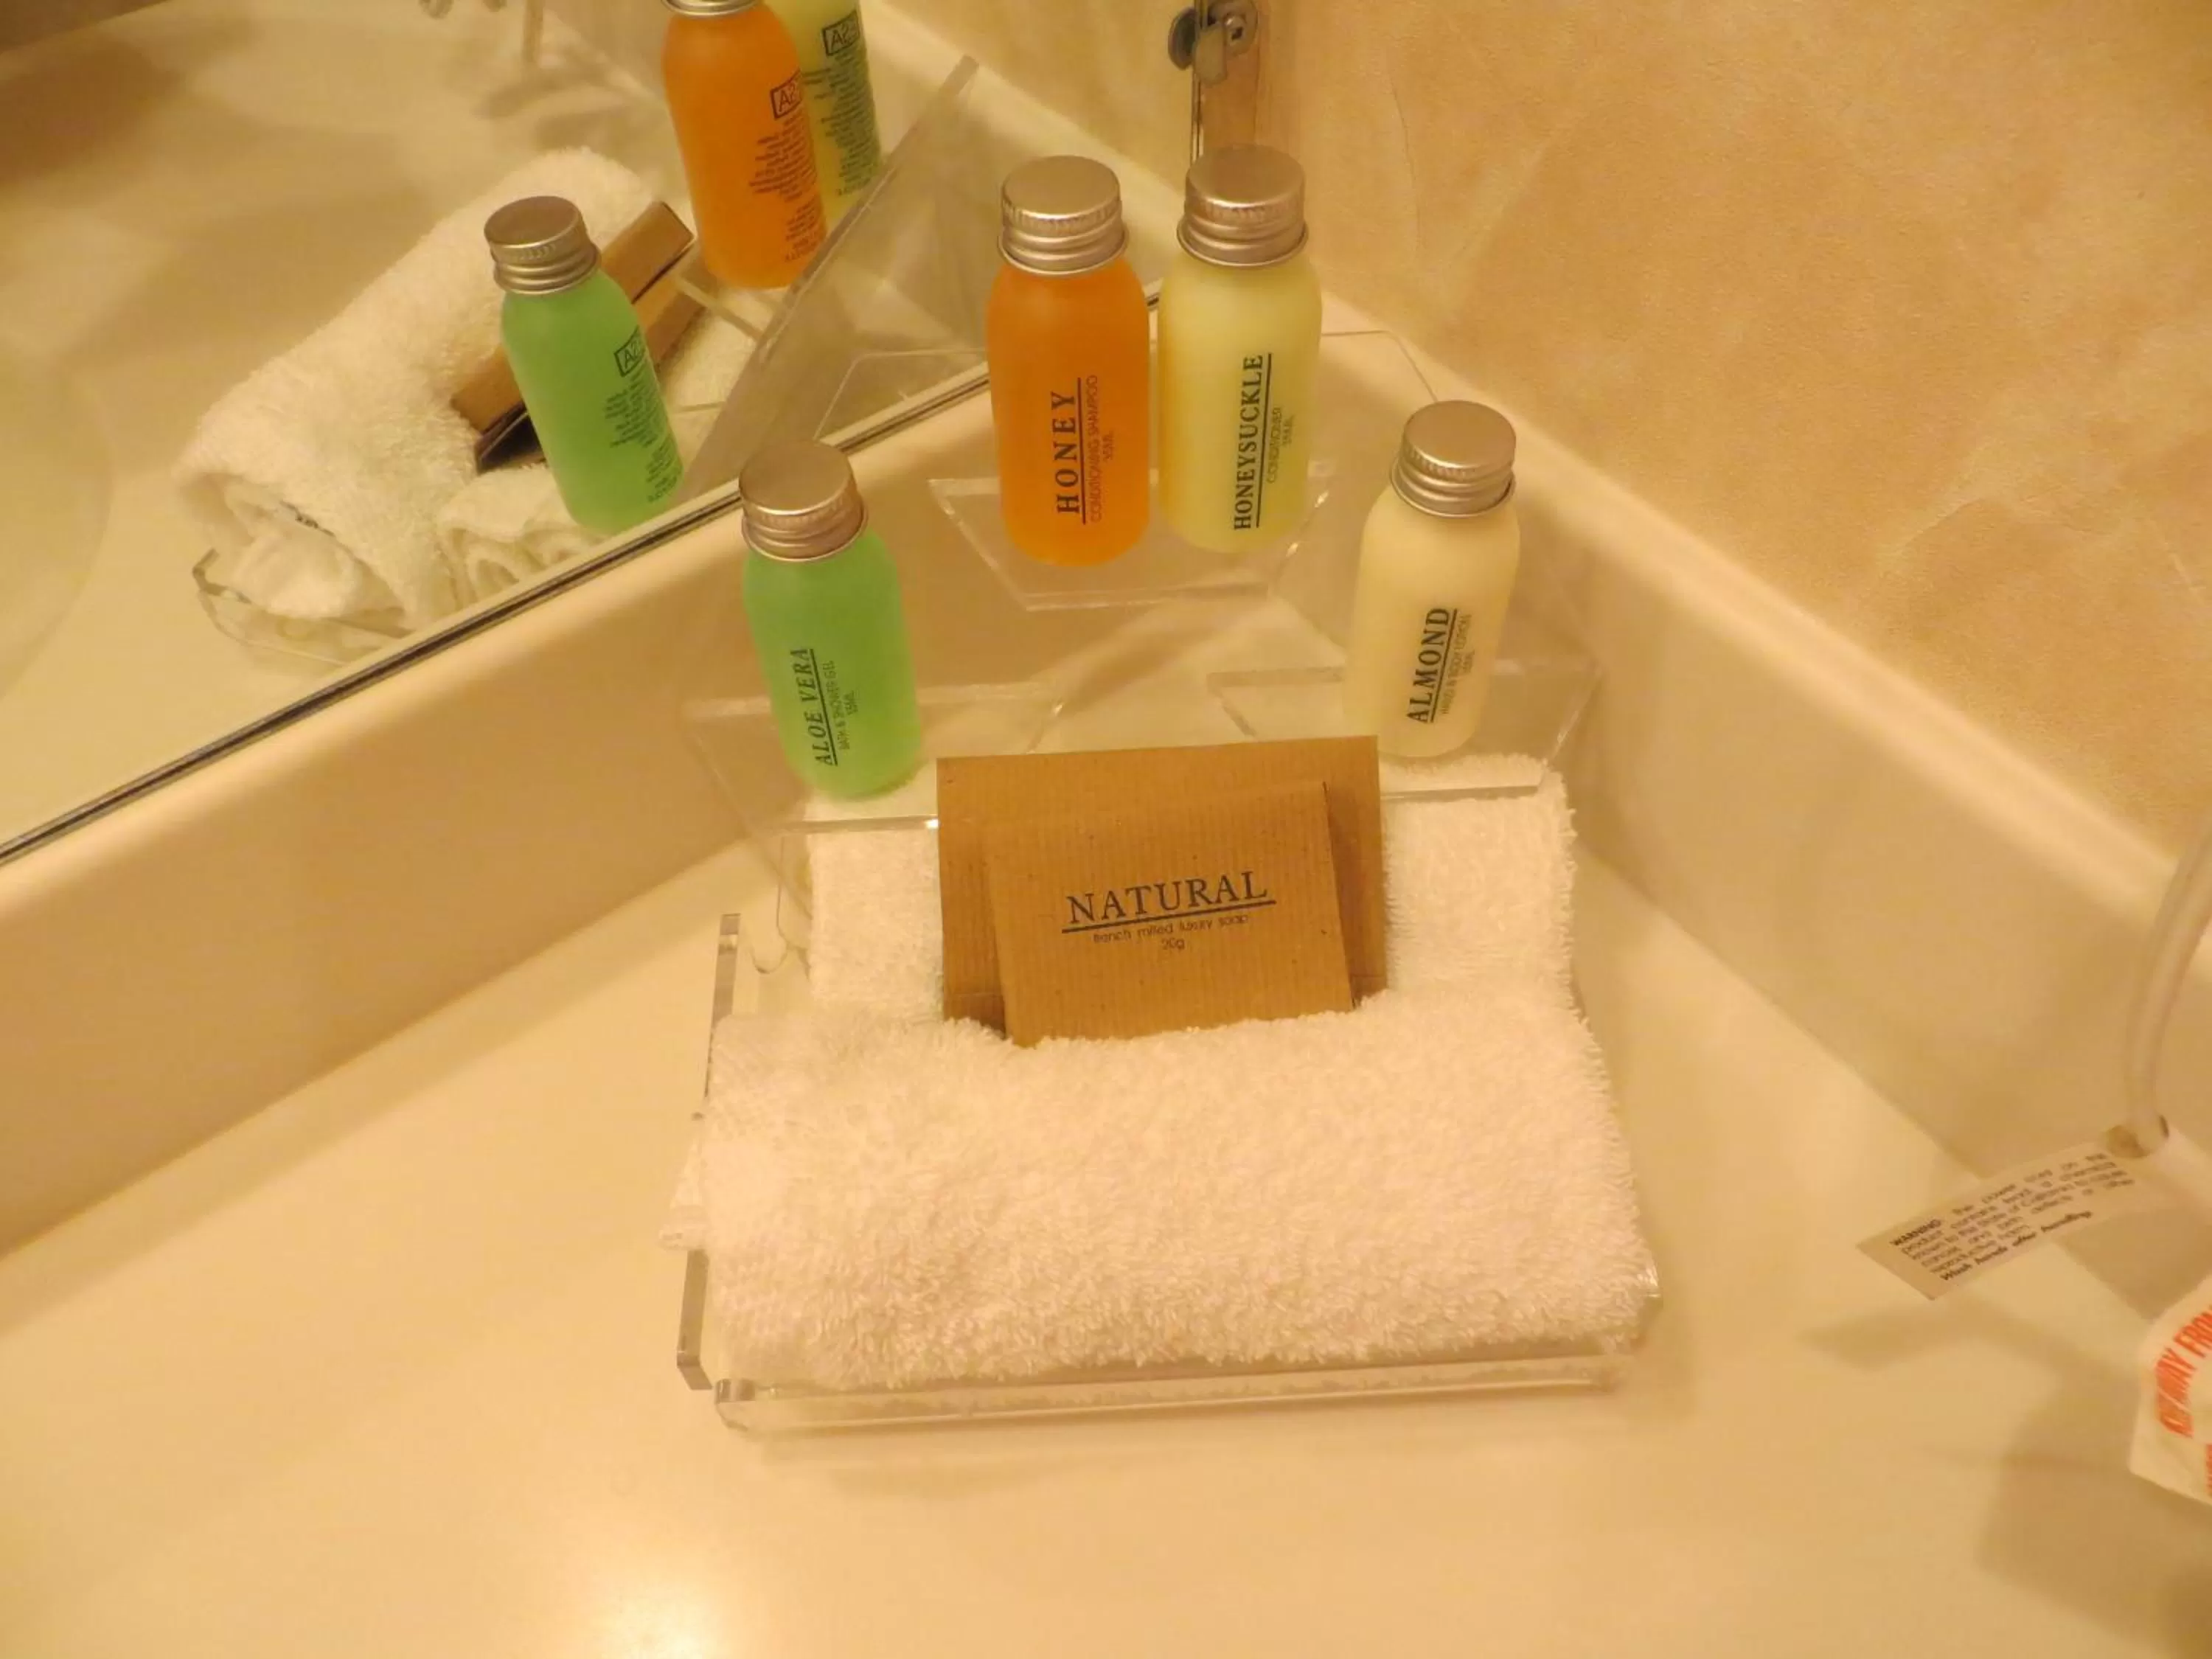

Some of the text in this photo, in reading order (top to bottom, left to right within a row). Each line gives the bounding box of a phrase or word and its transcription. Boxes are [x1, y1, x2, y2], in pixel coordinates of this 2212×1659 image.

[1050, 391, 1080, 514] HONEY
[1234, 355, 1263, 530] HONEYSUCKLE
[790, 648, 833, 766] ALOE VERA
[1406, 608, 1450, 724] ALMOND
[1066, 870, 1268, 924] NATURAL
[1136, 922, 1174, 938] milled
